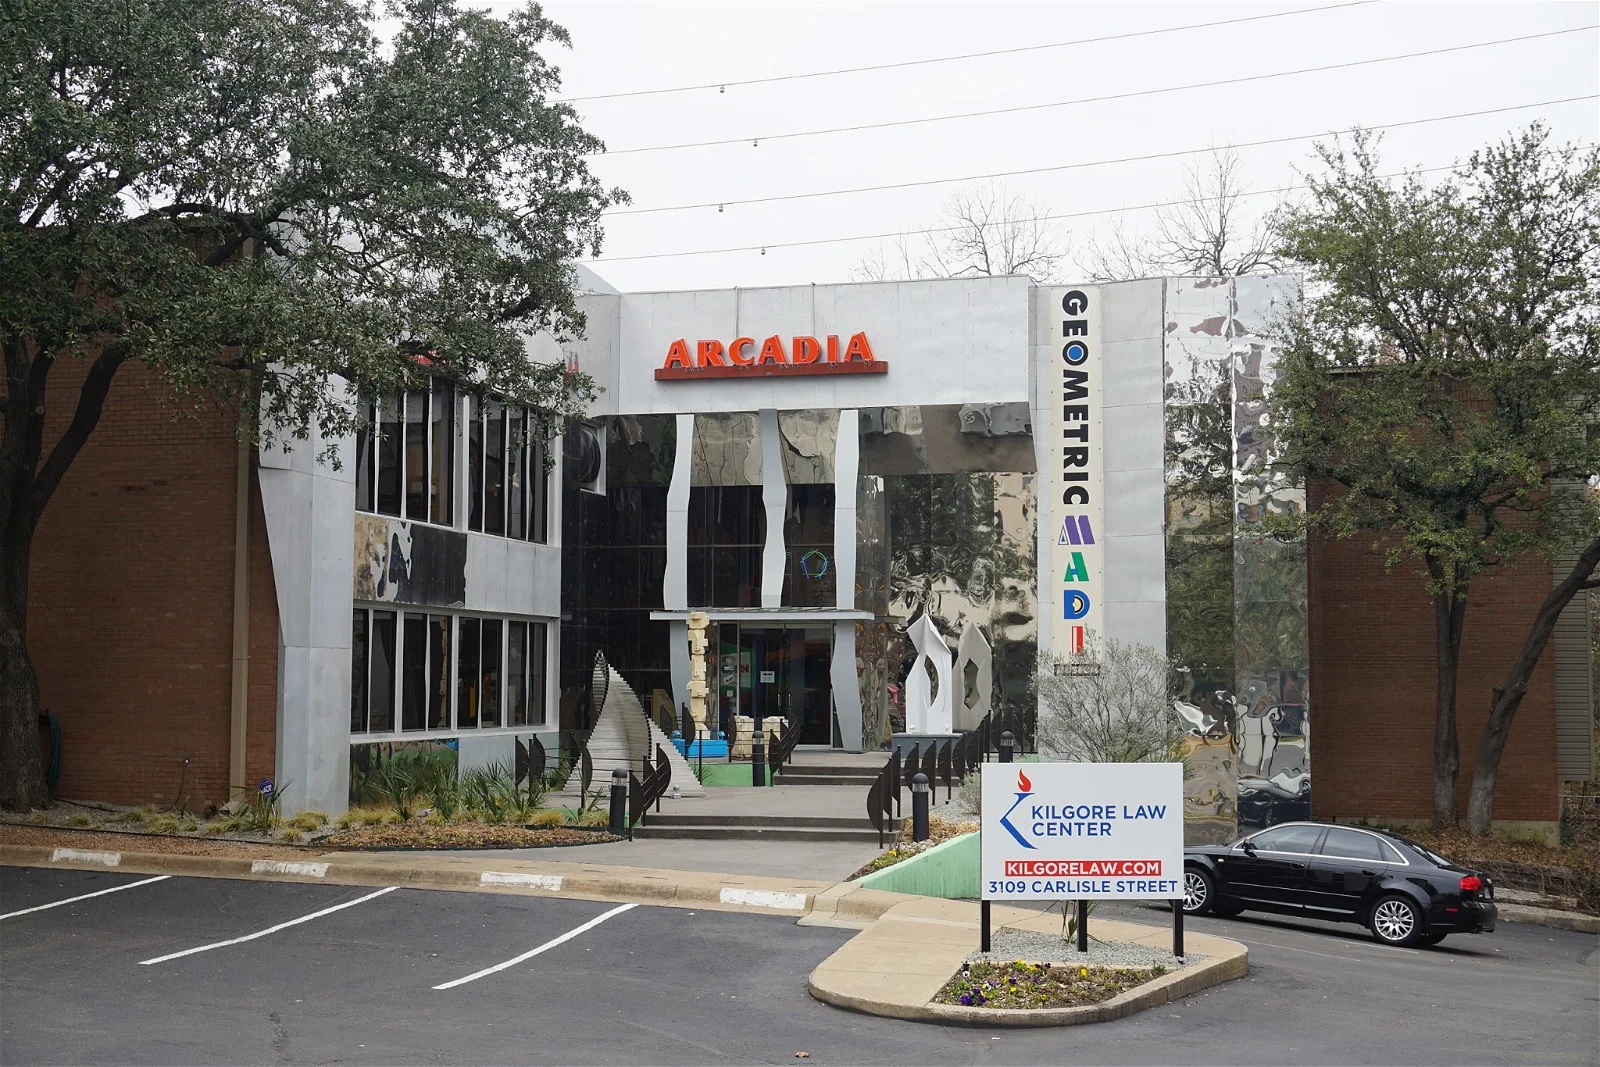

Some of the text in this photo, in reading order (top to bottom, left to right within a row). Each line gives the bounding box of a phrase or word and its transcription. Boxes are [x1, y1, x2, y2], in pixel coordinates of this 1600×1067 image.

[663, 331, 875, 368] ARCADIA
[1061, 289, 1090, 506] GEOMETRIC
[1058, 515, 1095, 655] MADI
[1031, 805, 1167, 820] KILGORE LAW
[1031, 822, 1112, 837] CENTER
[1007, 862, 1159, 876] KILGORELAW.COM
[988, 880, 1177, 894] 3109 CARLISLE STREET
